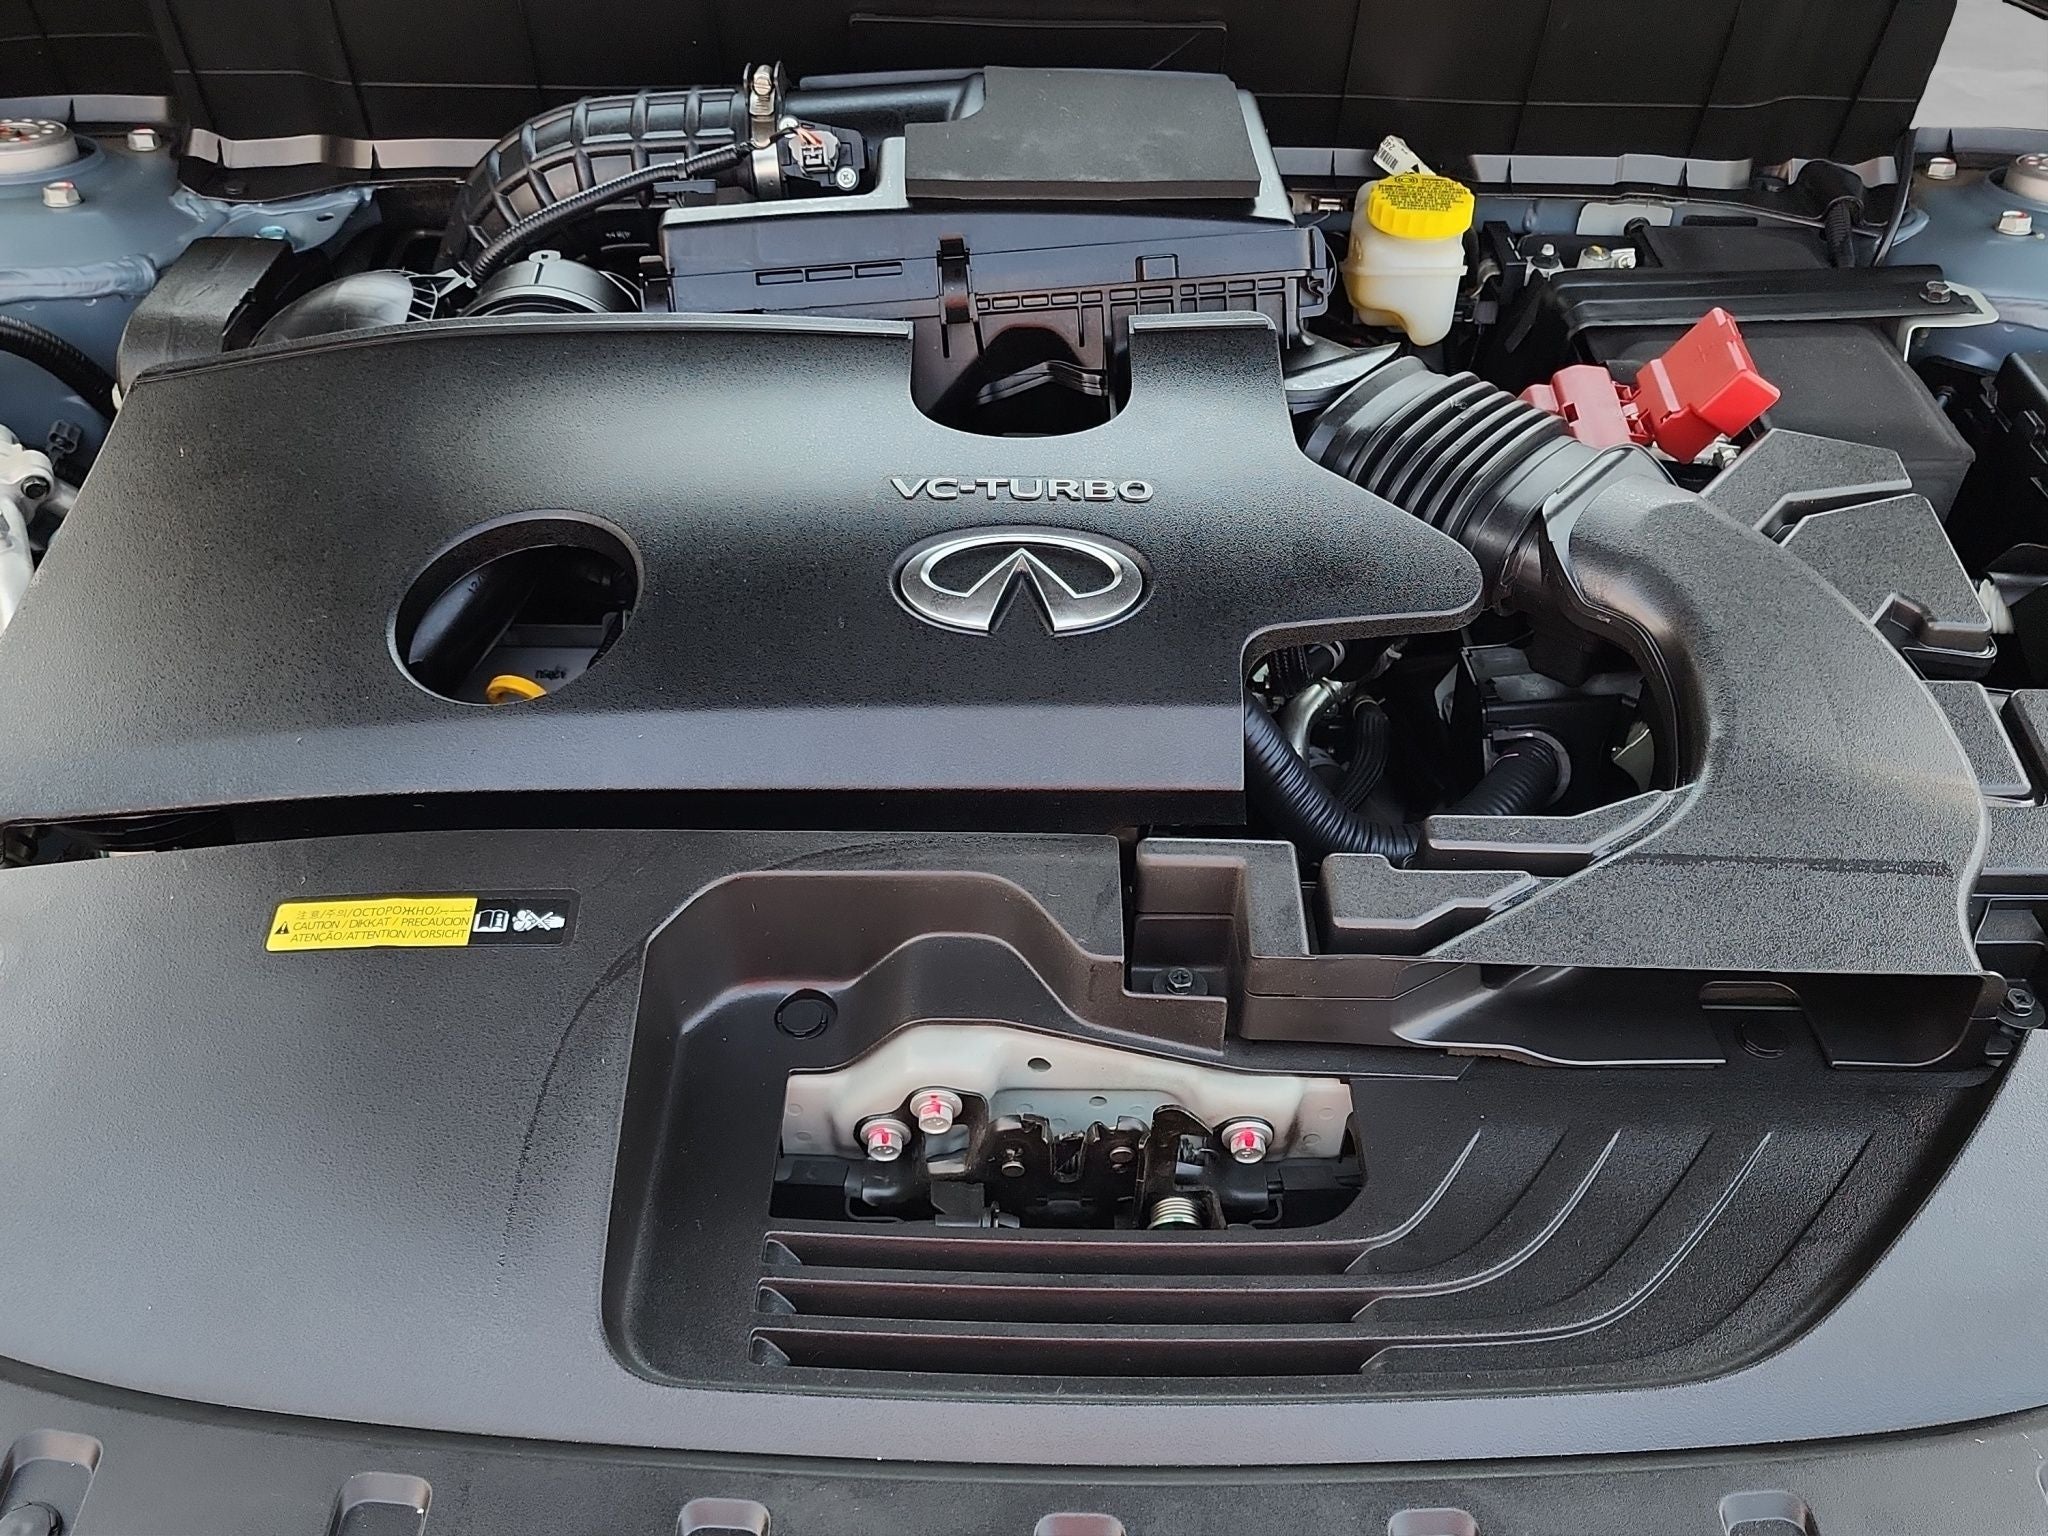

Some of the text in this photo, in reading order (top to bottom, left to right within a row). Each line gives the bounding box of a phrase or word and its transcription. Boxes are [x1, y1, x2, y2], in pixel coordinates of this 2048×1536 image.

[890, 477, 1154, 503] VC-TURBO
[293, 920, 340, 931] CAUTION
[349, 917, 391, 929] DIKKAT
